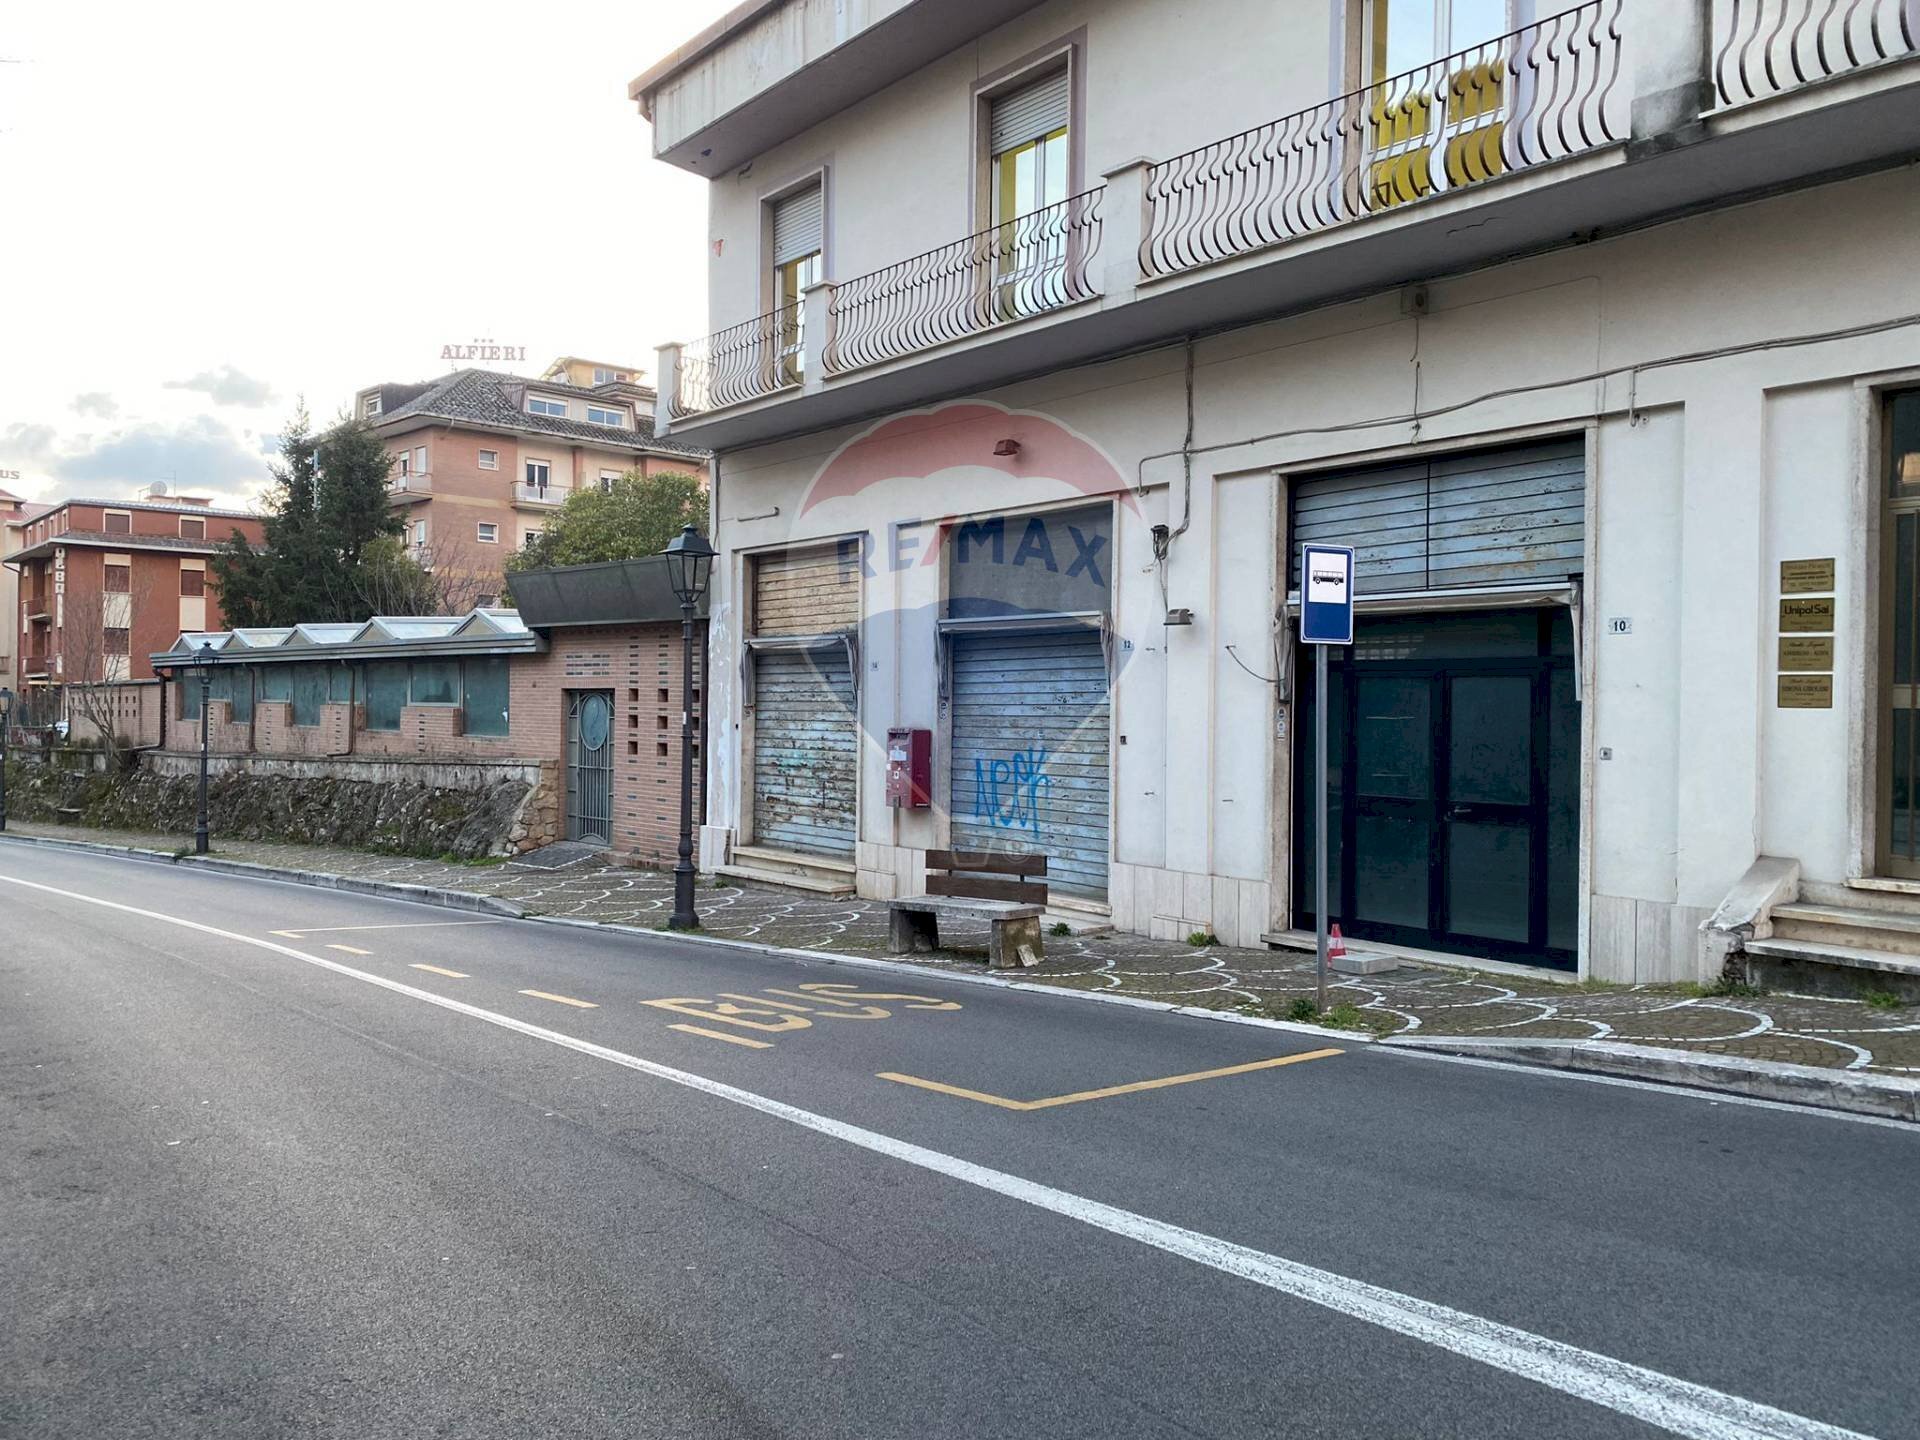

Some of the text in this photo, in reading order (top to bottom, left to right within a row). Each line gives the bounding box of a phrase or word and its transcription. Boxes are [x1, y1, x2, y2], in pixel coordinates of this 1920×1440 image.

[440, 344, 526, 360] ALFIERI
[1614, 620, 1626, 632] 10
[638, 983, 963, 1033] BUS
